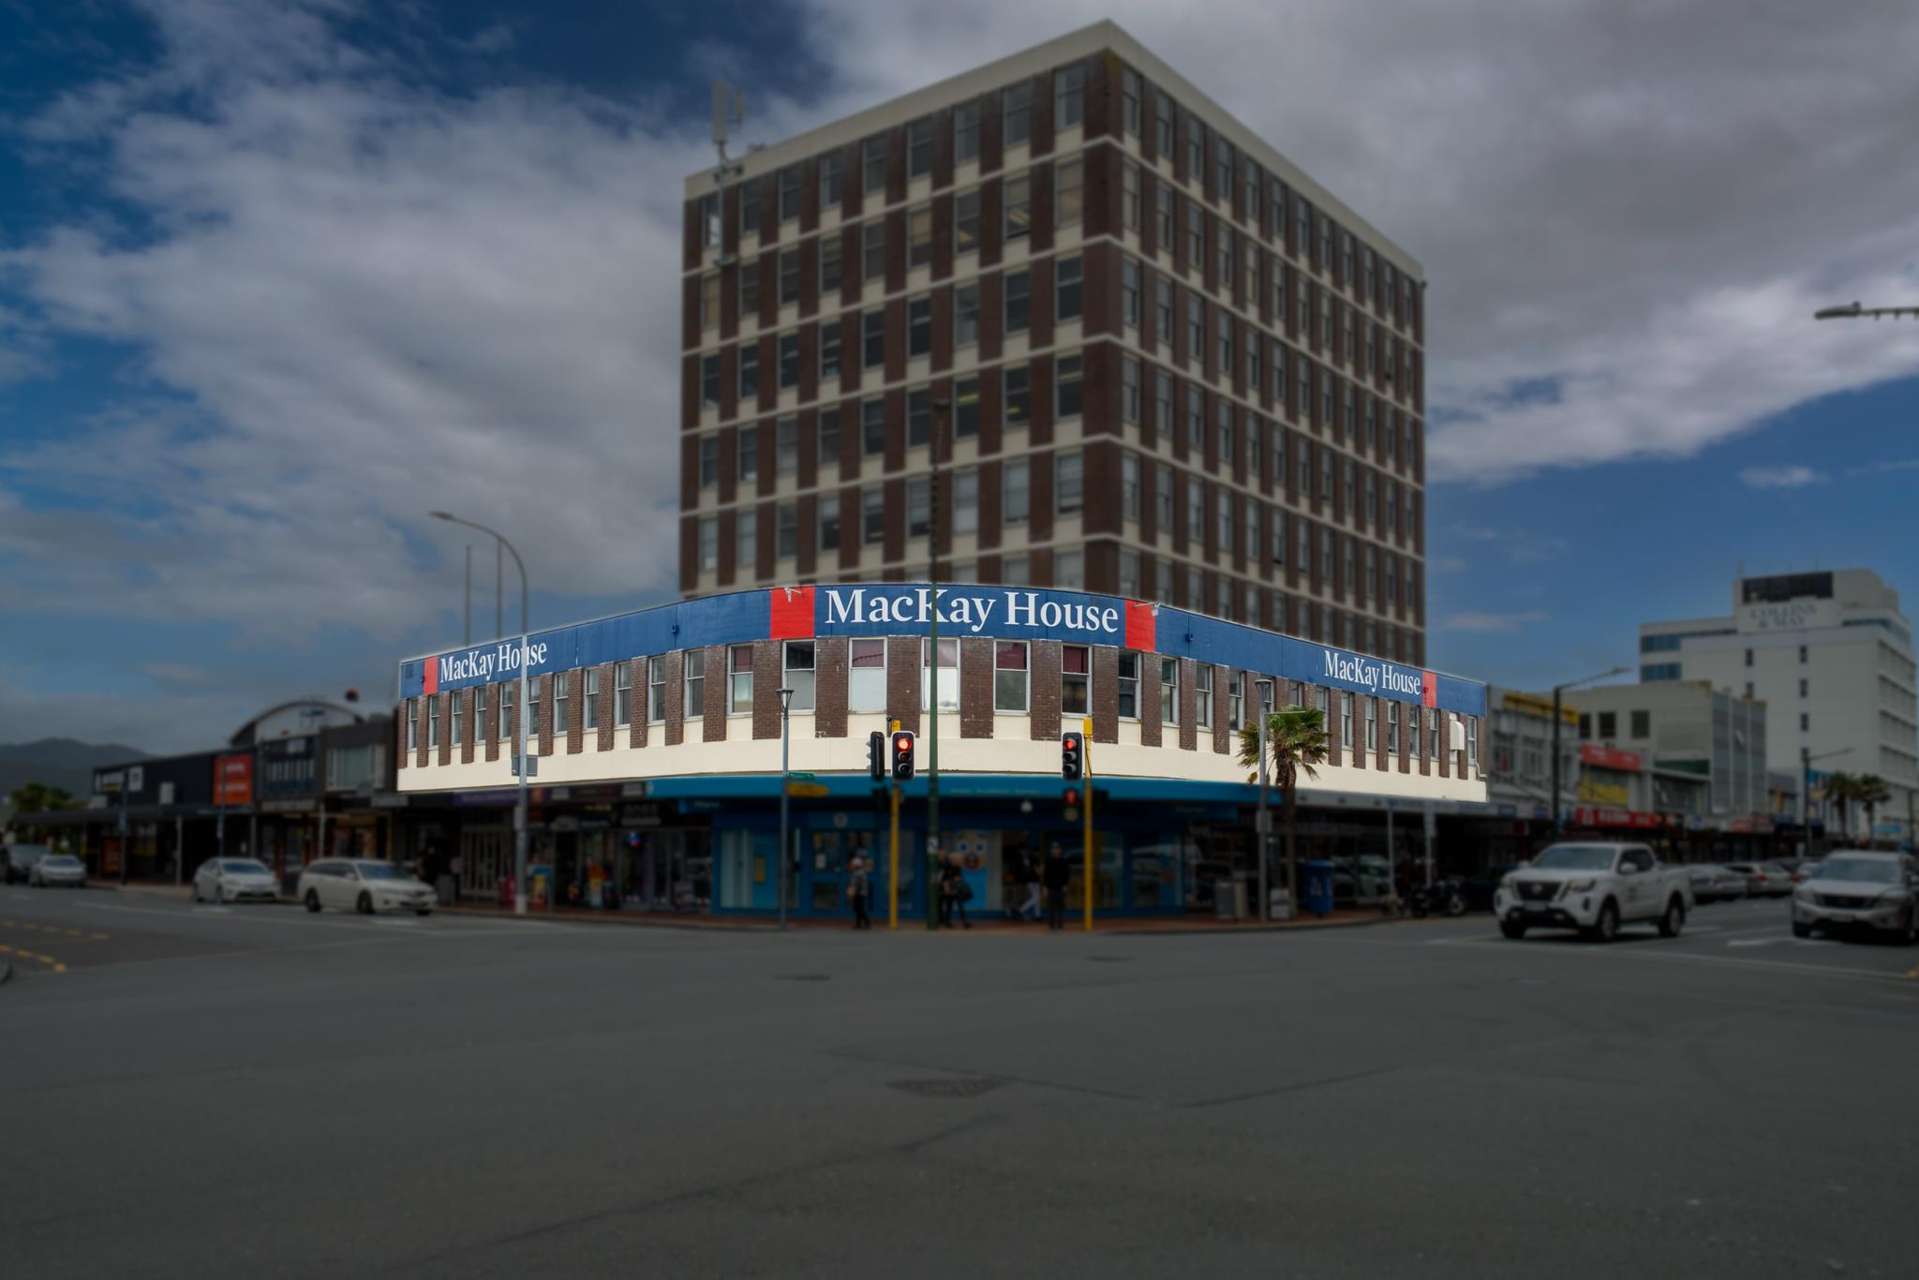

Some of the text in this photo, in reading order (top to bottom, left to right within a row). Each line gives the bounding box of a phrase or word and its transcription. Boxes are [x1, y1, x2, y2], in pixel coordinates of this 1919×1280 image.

[825, 588, 1119, 632] MacKay House
[440, 650, 497, 683] MacKay
[1324, 650, 1421, 696] MacKay House
